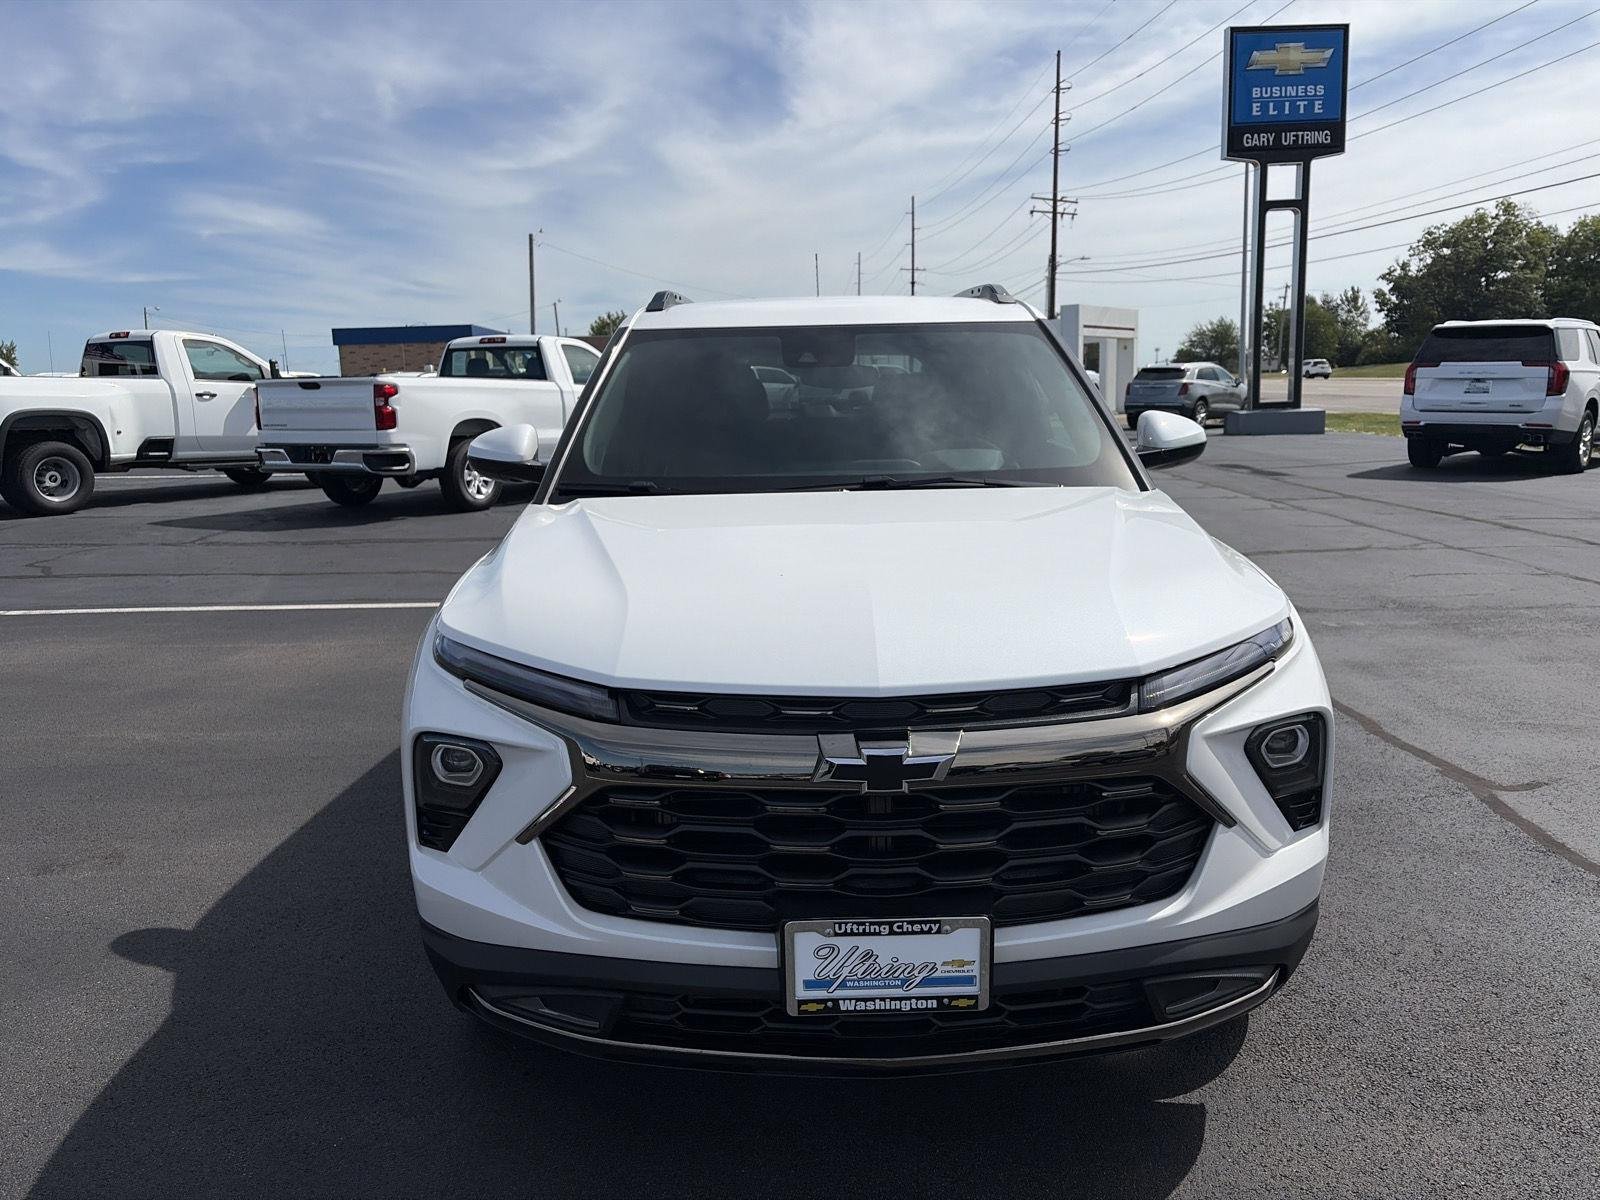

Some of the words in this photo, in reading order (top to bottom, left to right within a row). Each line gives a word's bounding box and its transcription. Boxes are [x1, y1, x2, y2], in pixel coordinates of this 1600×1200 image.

[1252, 85, 1325, 97] BUSINESS
[1252, 101, 1323, 115] ELITE
[1243, 133, 1275, 147] GARY
[1281, 130, 1331, 145] UFTRING
[834, 923, 890, 935] Uftring
[892, 921, 940, 933] Chevy
[813, 943, 938, 993] Uftring
[846, 979, 902, 988] WASHINGTON
[838, 998, 938, 1011] Washington
